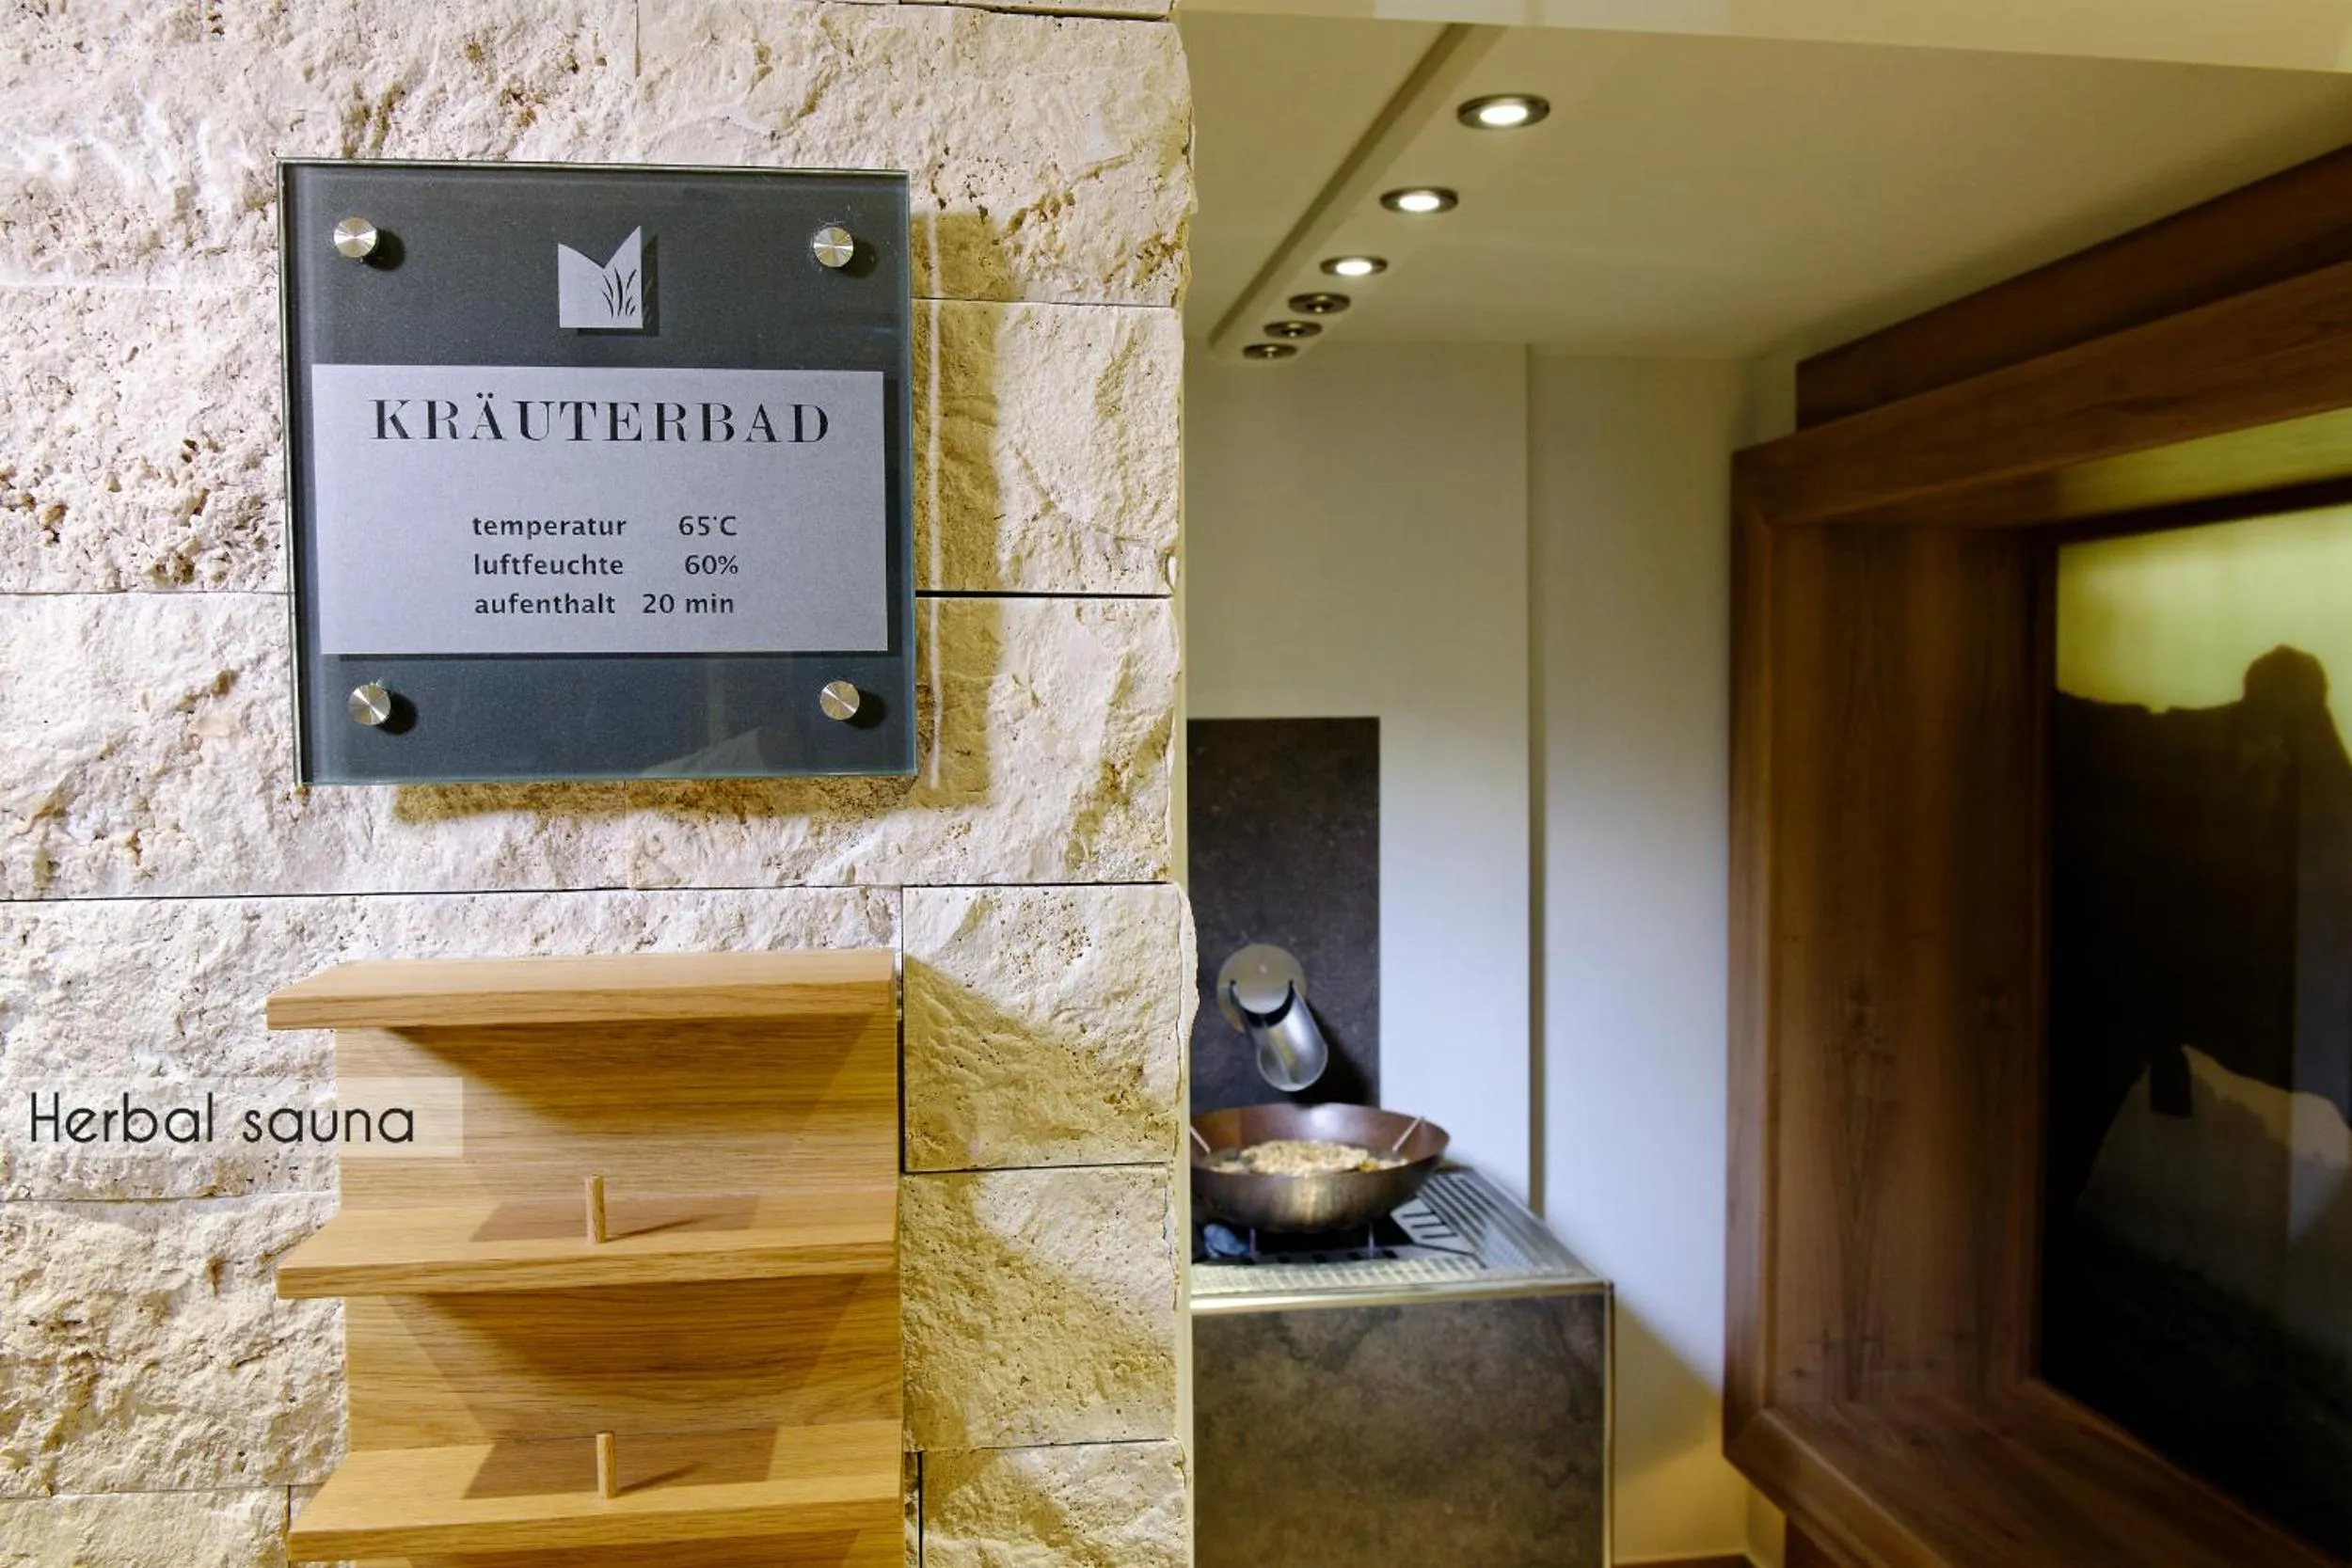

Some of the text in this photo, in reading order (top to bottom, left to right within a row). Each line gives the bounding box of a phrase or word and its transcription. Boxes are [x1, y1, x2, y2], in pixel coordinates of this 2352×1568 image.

[371, 392, 829, 443] KRÄUTERBAD
[472, 517, 628, 540] temperatur
[473, 553, 739, 576] luftfeuchte 60%
[474, 592, 734, 614] aufenthalt 20 min
